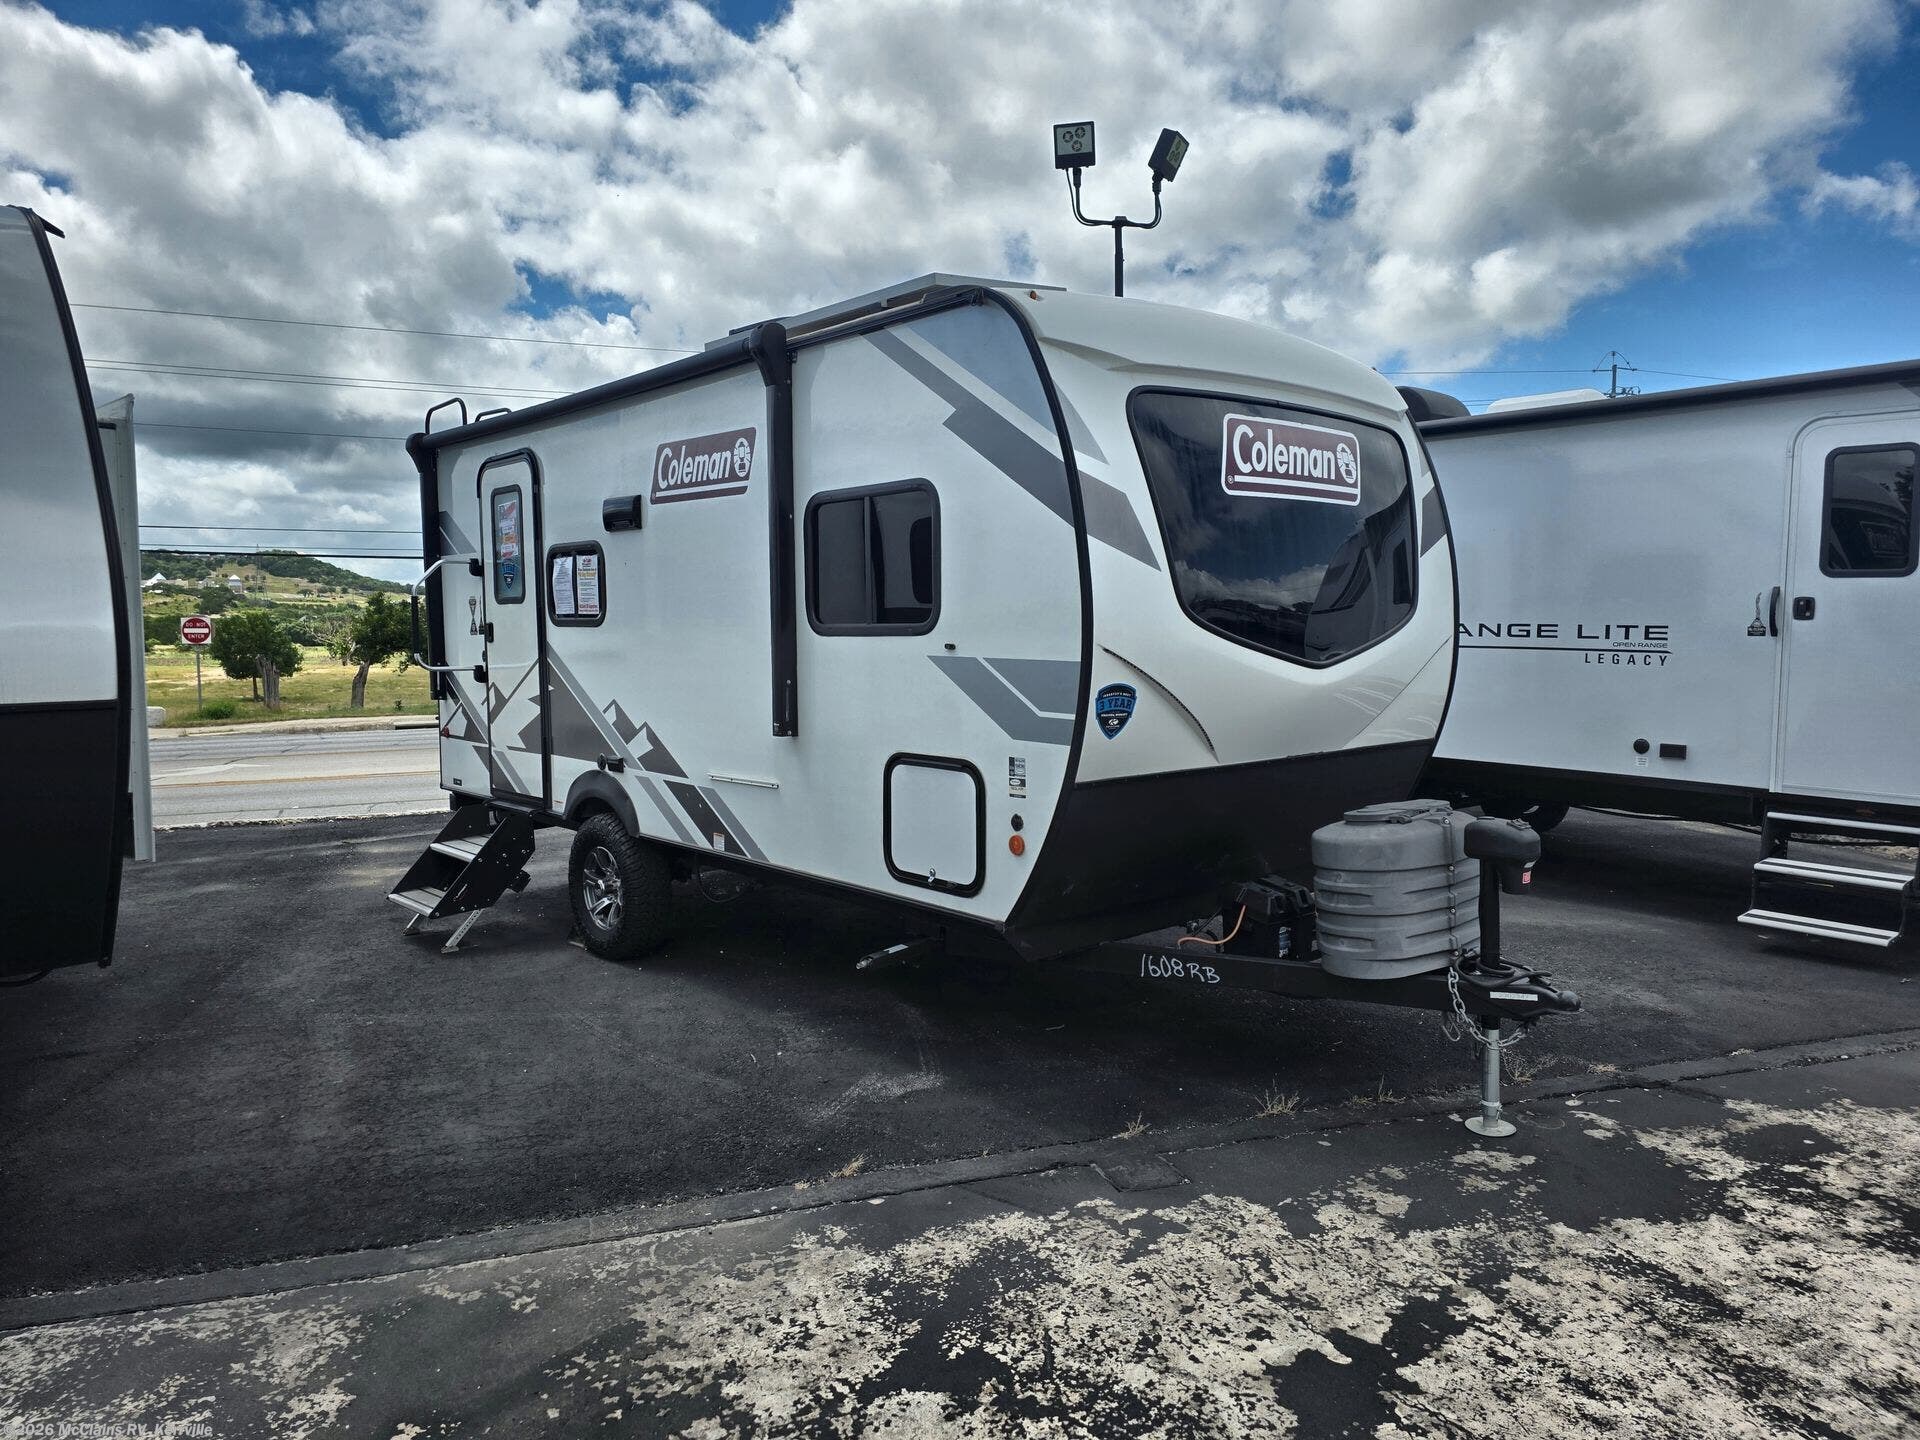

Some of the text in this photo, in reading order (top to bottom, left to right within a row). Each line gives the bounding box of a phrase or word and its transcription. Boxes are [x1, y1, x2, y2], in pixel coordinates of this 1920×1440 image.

[1233, 424, 1336, 480] Coleman
[657, 445, 732, 490] Coleman
[1577, 624, 1669, 641] LITE
[1584, 653, 1668, 667] LEGACY
[1107, 697, 1132, 710] YEAR
